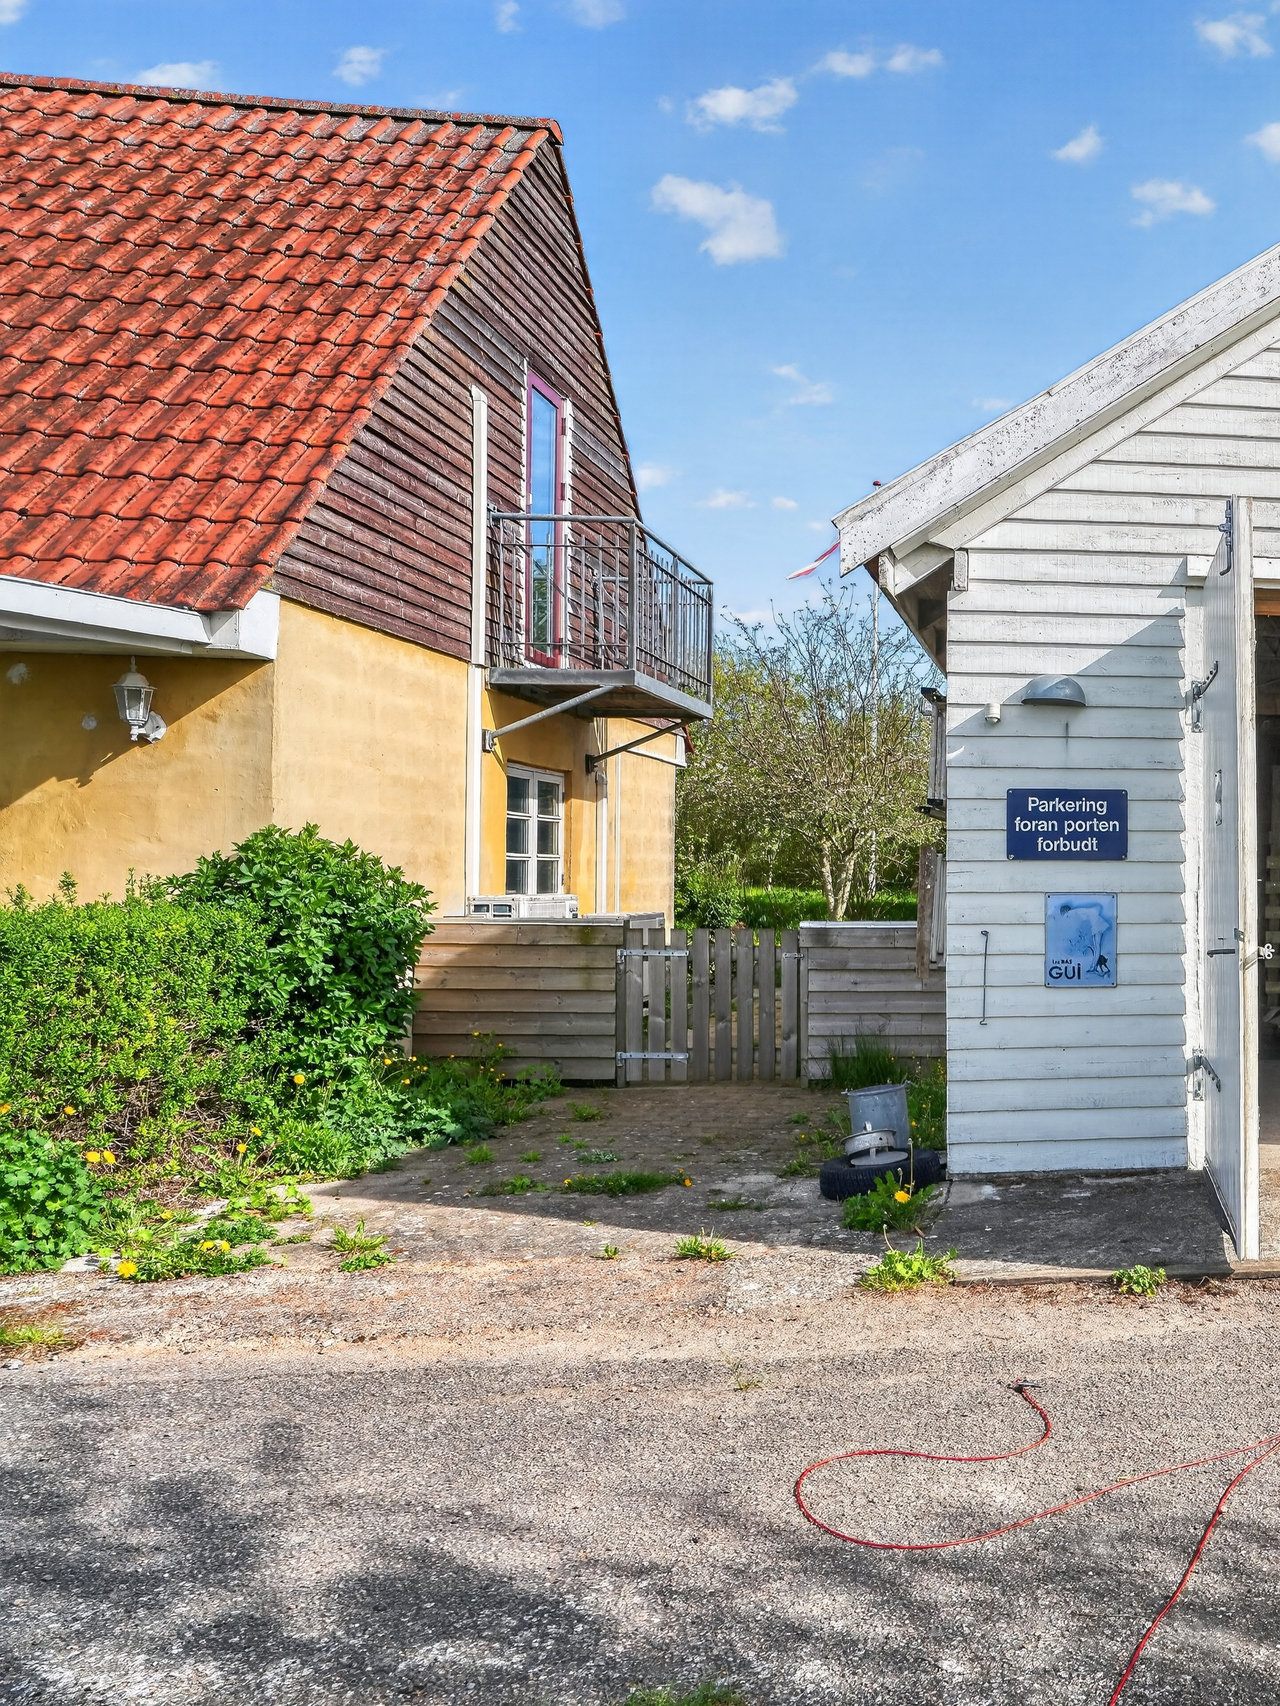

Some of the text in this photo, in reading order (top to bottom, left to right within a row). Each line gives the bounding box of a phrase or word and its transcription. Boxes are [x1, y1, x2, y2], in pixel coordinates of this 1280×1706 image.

[1028, 795, 1107, 816] Parkering
[1014, 816, 1120, 835] foran porten
[1037, 836, 1098, 852] forbudt
